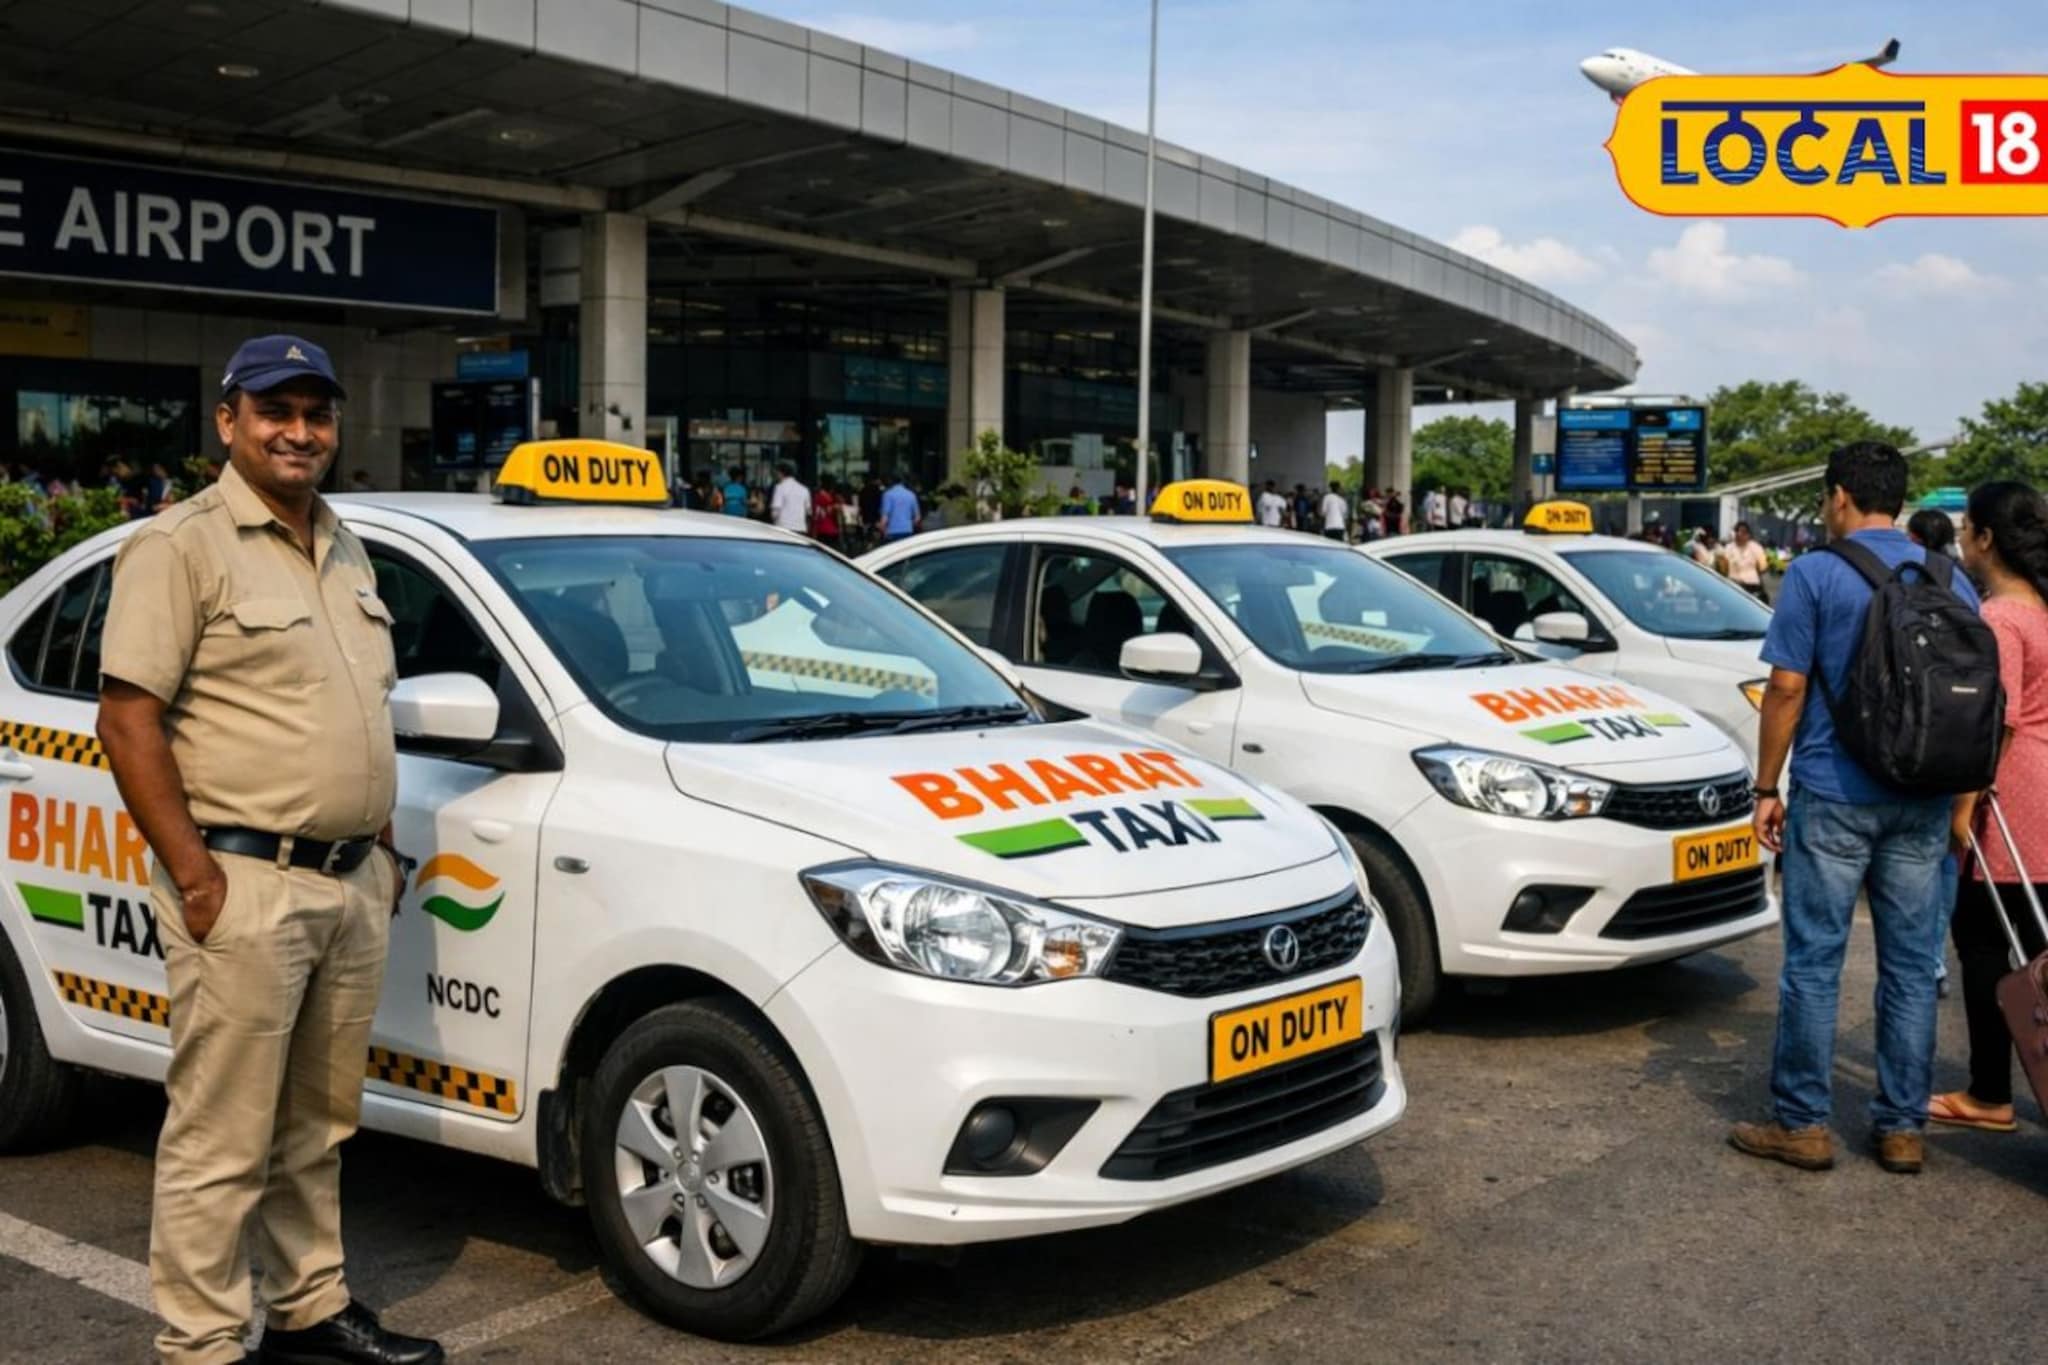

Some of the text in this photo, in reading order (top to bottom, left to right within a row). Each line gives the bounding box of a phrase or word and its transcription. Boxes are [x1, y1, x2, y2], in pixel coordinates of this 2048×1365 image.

[54, 187, 376, 277] AIRPORT
[544, 453, 651, 487] ON DUTY
[1183, 491, 1243, 511] ON DUTY
[1469, 685, 1648, 723] BHARAT
[1578, 714, 1662, 741] TAXI
[890, 751, 1206, 820] BHARAT
[1069, 801, 1222, 853] TAXI
[1687, 837, 1751, 870] ON DUTY
[426, 973, 501, 1019] NCDC
[1231, 997, 1350, 1063] ON DUTY
